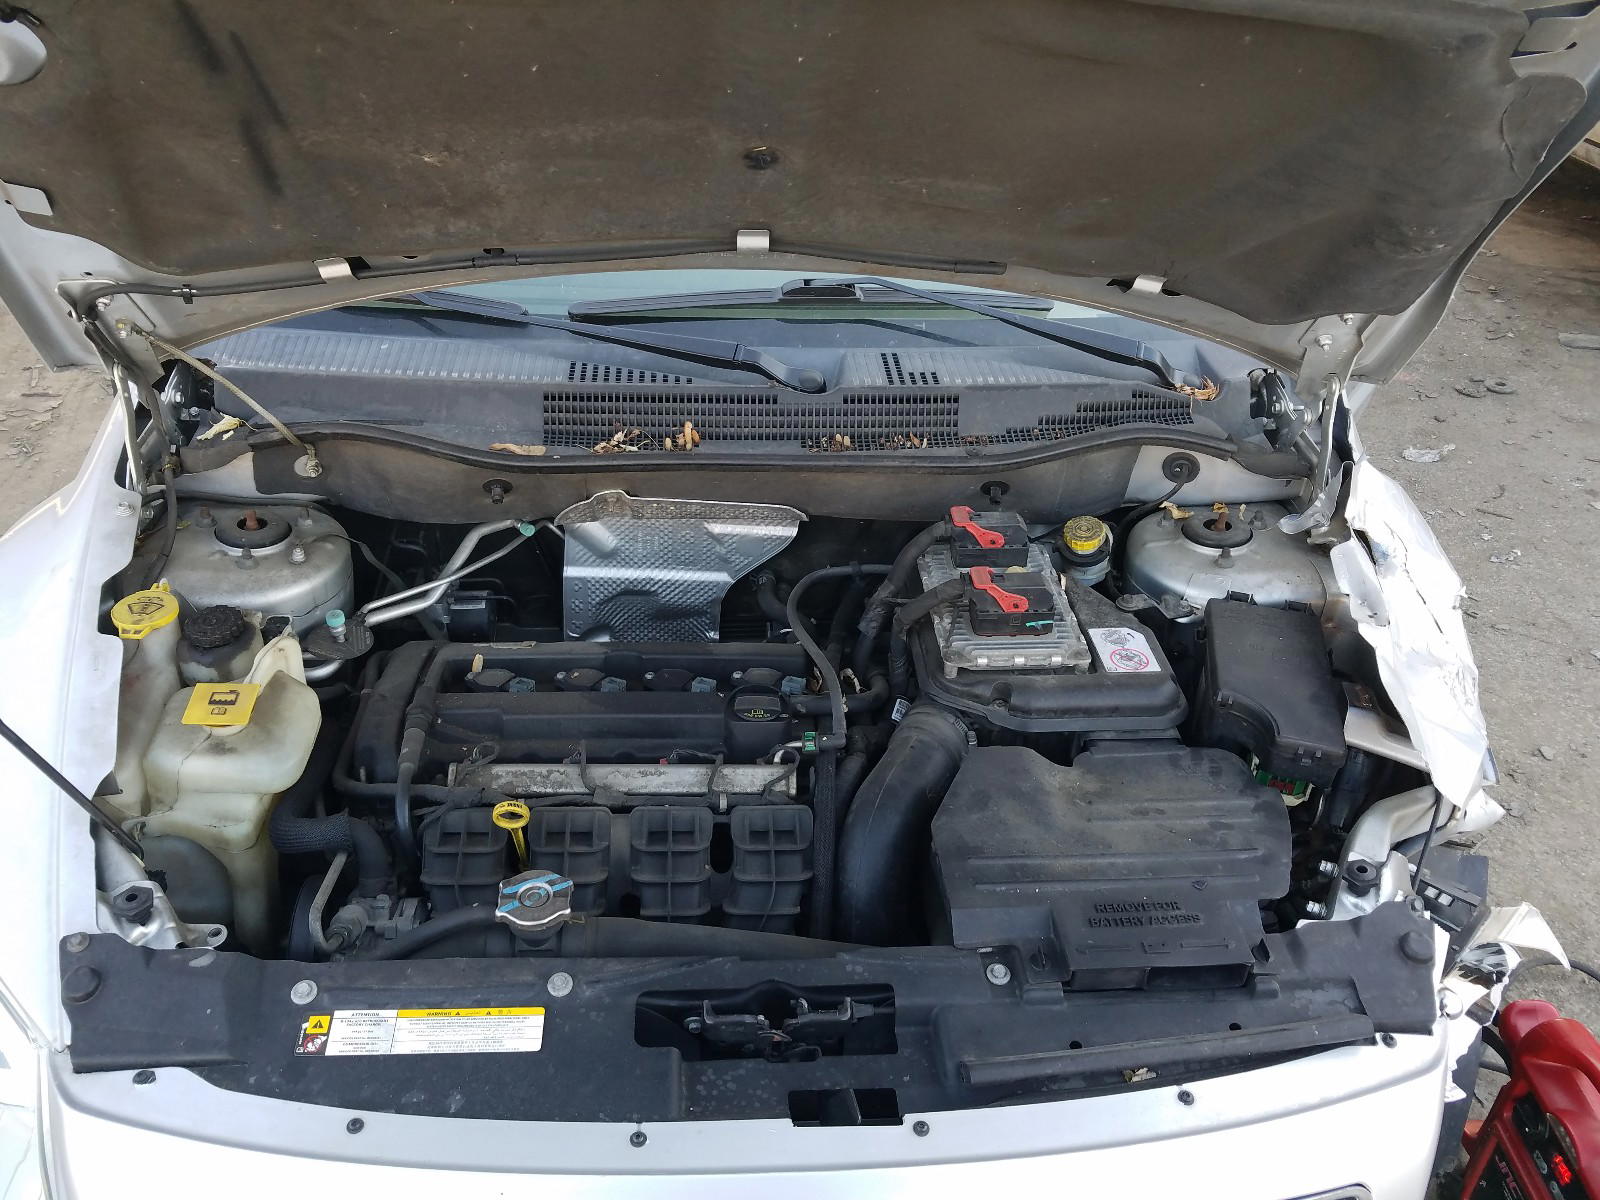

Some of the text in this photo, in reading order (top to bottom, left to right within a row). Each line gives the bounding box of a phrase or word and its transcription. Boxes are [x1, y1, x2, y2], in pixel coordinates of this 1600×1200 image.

[1094, 901, 1182, 913] REMOVE FOR
[1088, 914, 1201, 928] BATTERY ACCESS
